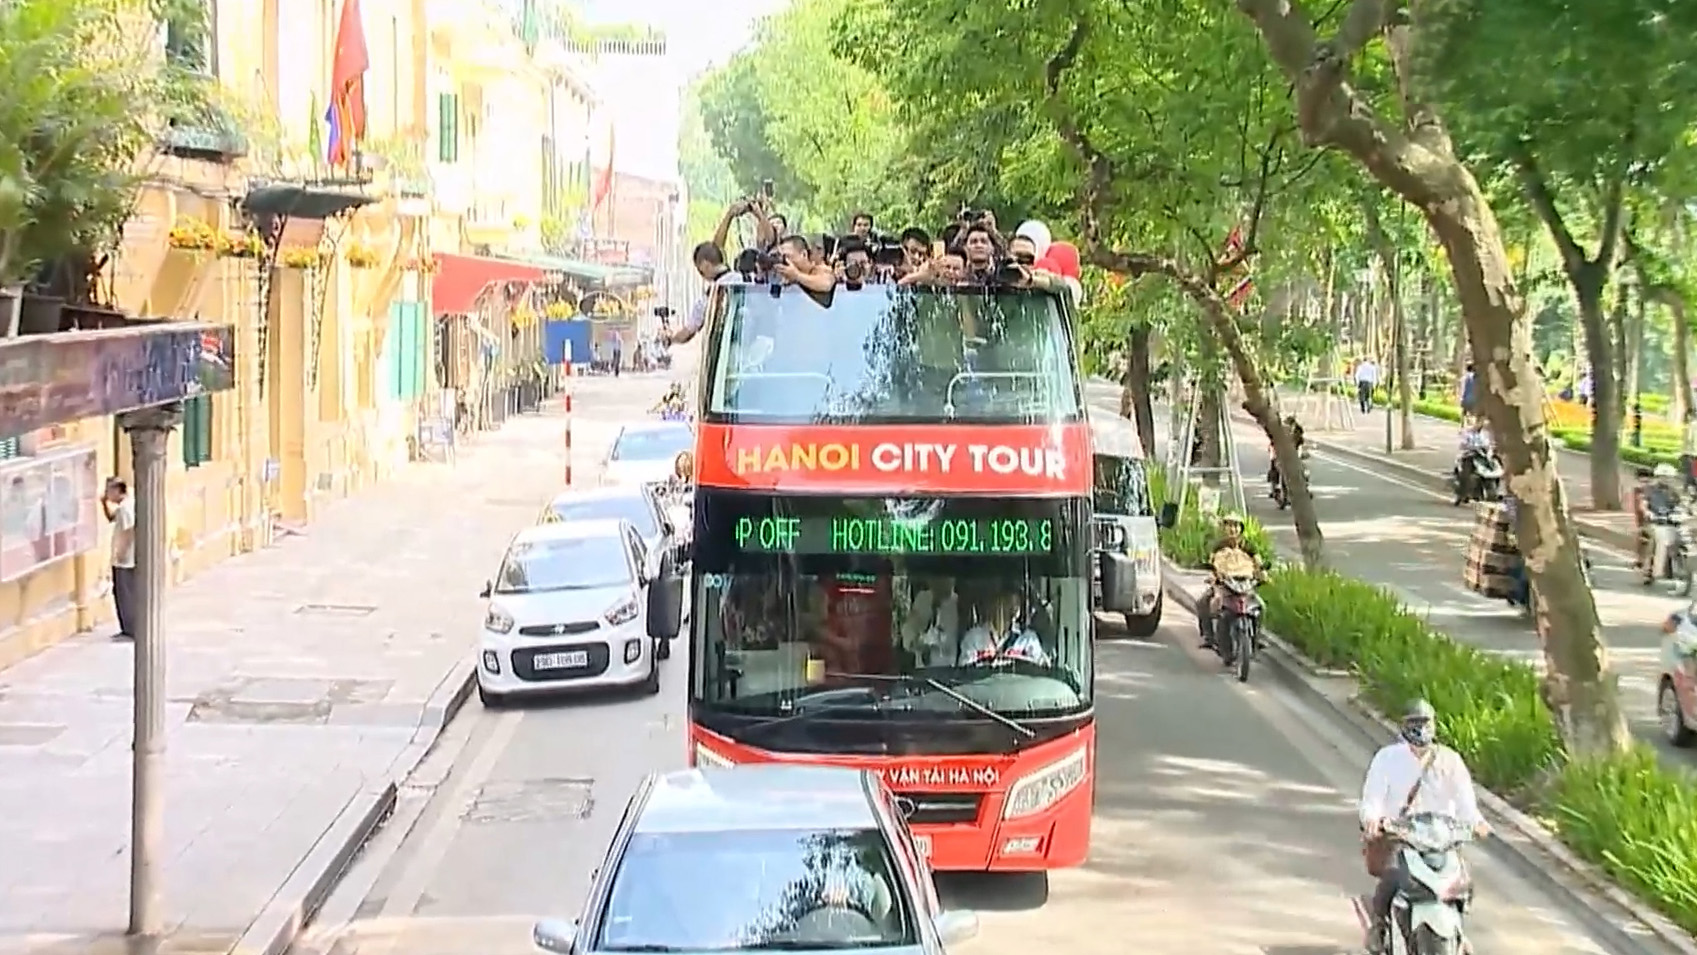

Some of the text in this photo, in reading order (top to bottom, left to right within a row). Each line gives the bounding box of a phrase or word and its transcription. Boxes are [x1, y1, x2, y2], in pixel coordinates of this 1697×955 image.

[737, 443, 1066, 480] HANOI CITY TOUR
[735, 518, 753, 548] P
[759, 518, 801, 551] OFF
